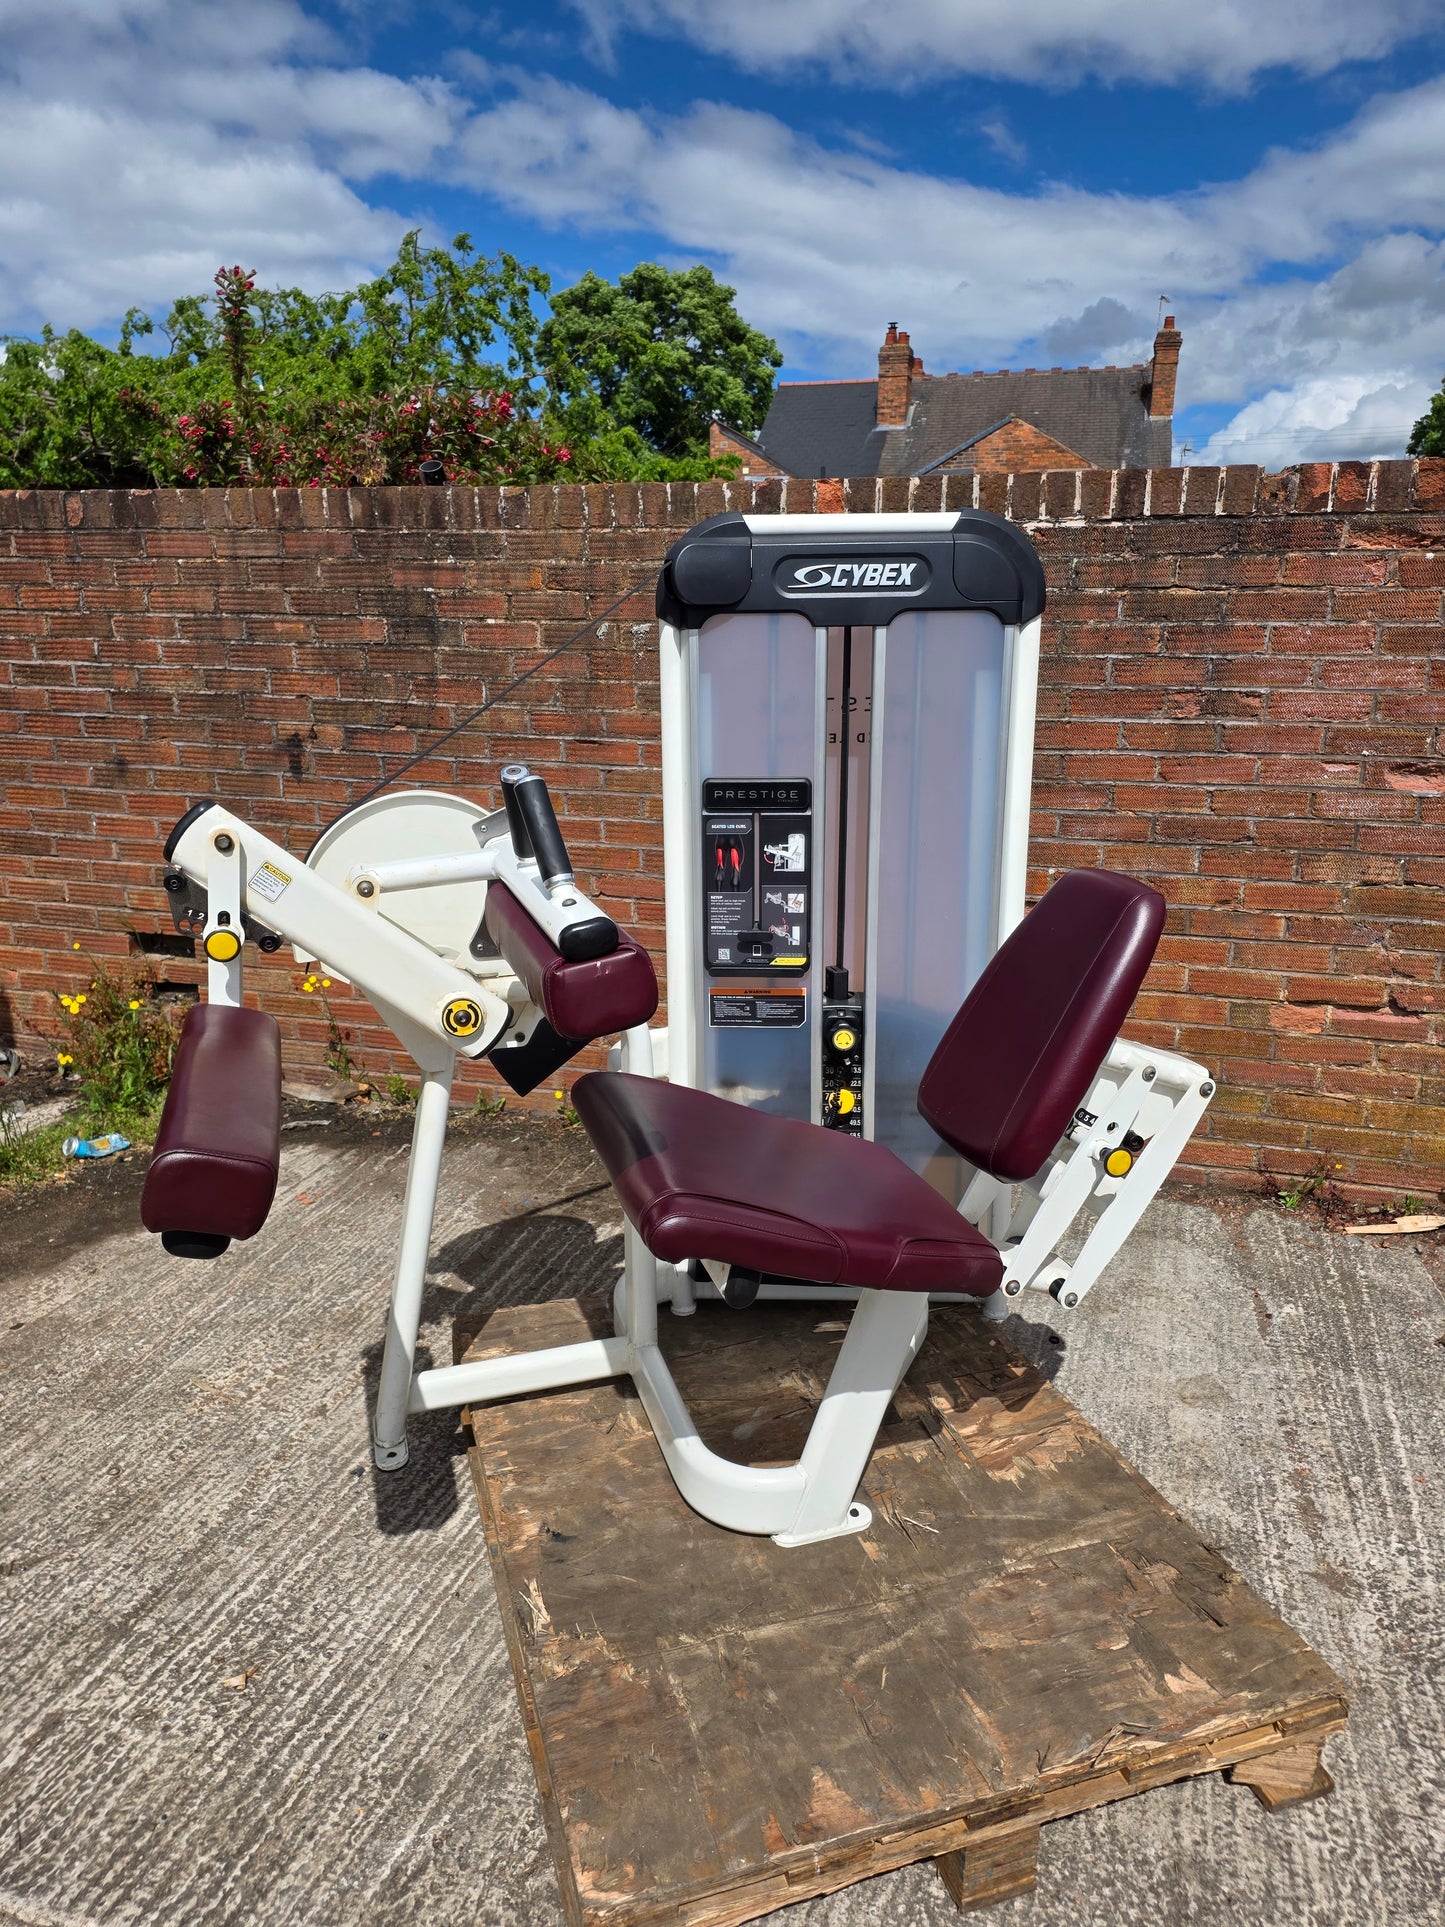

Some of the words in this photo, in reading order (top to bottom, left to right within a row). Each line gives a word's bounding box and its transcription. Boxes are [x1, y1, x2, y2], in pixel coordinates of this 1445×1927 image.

[830, 563, 917, 587] CYBEX
[714, 790, 799, 799] PRESTIGE
[269, 867, 289, 882] CAUTION
[187, 909, 193, 917] 1
[198, 912, 205, 920] 2
